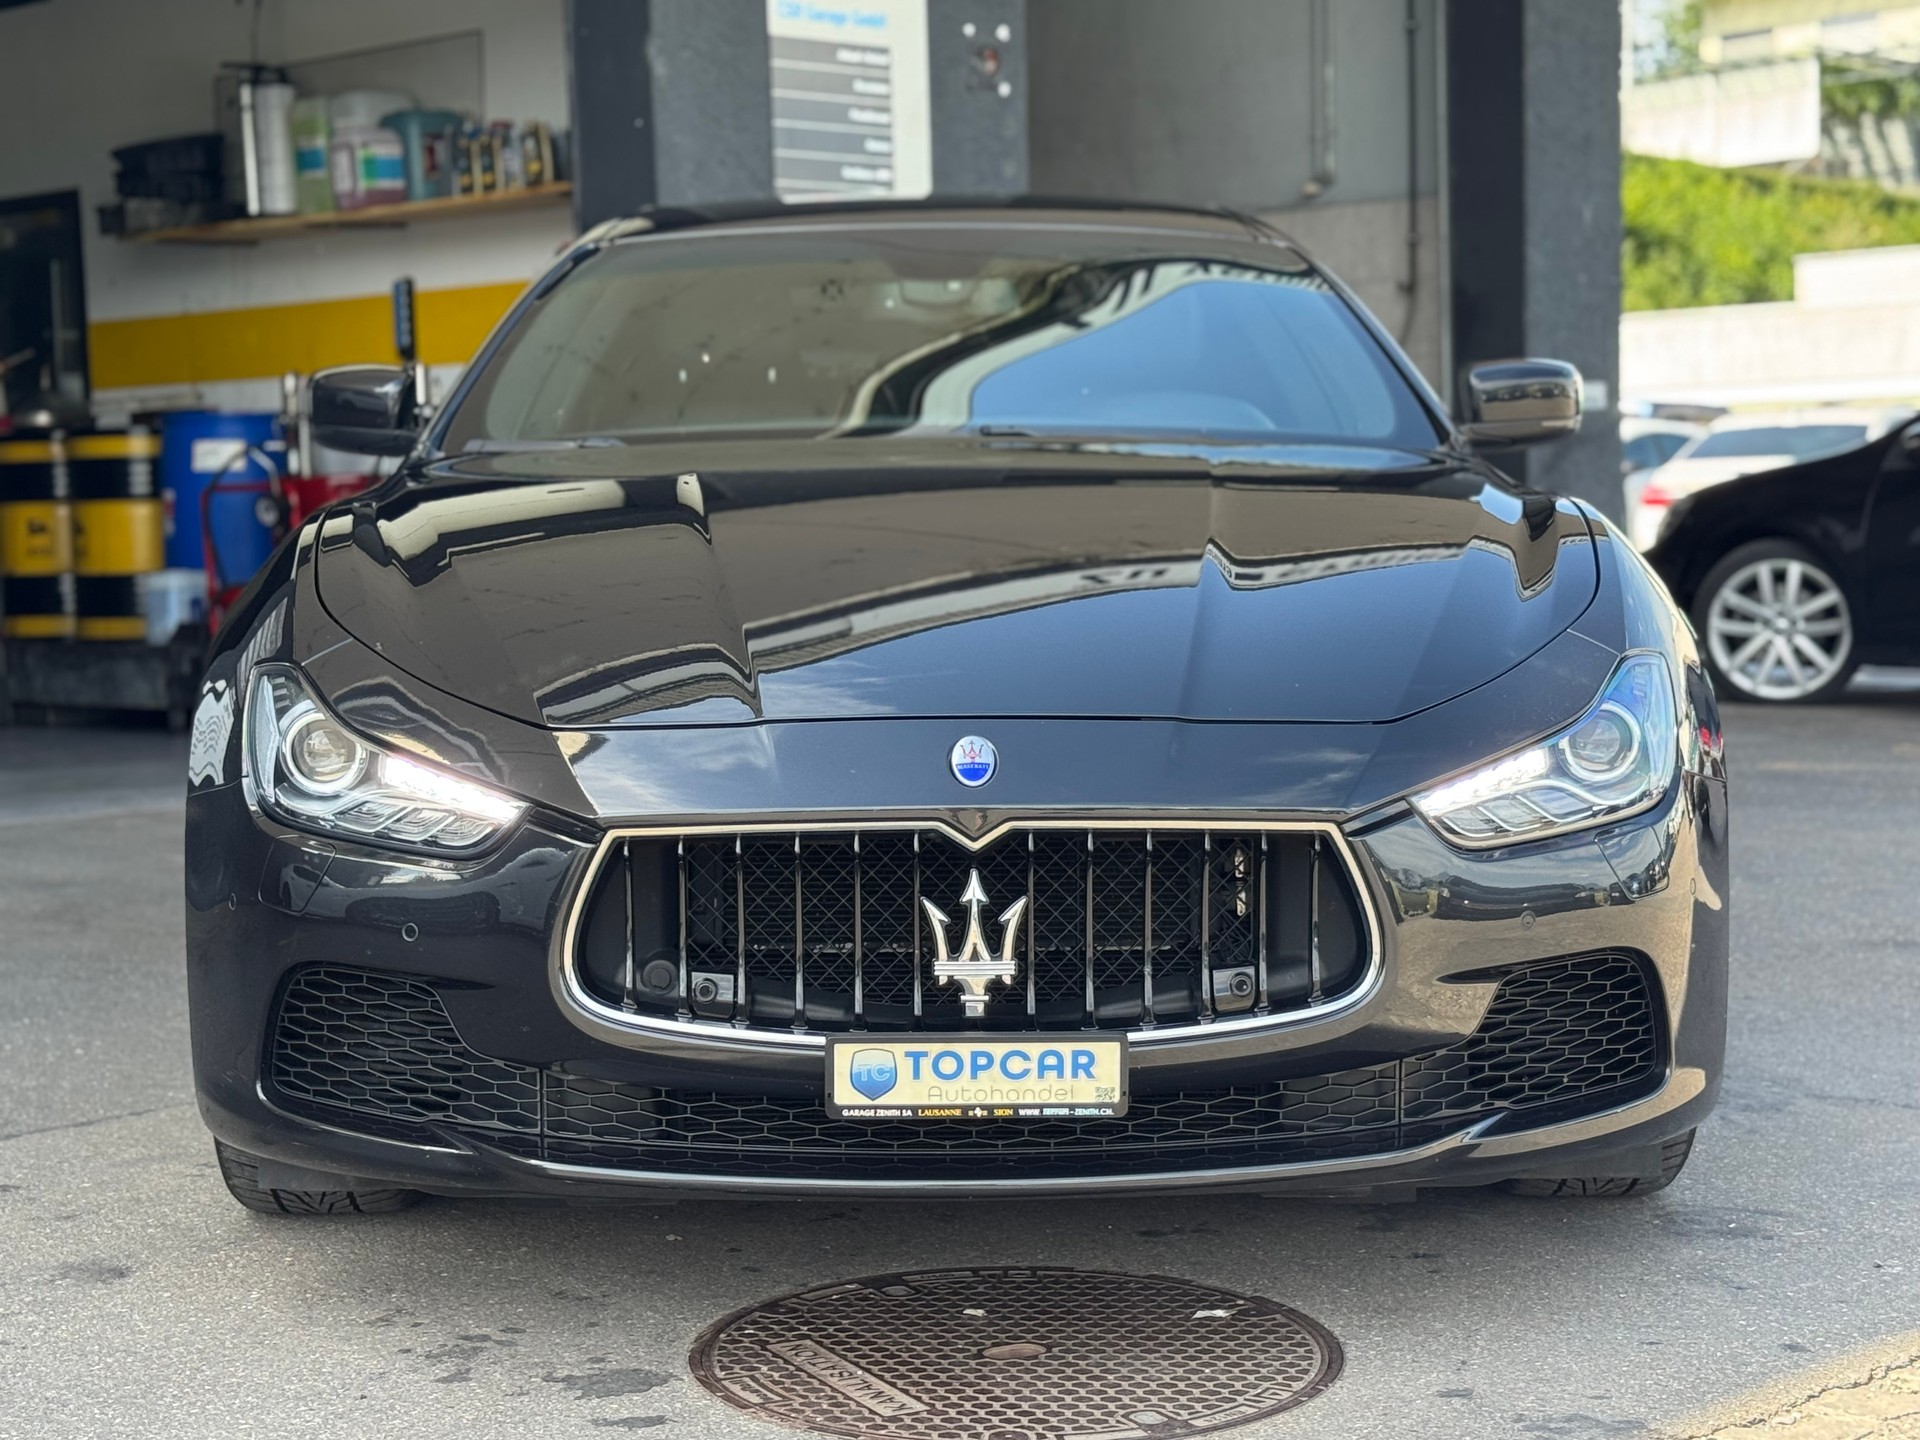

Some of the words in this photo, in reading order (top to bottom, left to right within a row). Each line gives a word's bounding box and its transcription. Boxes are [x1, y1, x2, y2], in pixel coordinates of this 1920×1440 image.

[857, 1063, 891, 1082] TC
[904, 1049, 1097, 1081] TOPCAR
[928, 1084, 1074, 1102] Autohandel
[842, 1108, 875, 1117] GARAGE
[902, 1108, 913, 1117] SA
[917, 1108, 963, 1117] LAUSANNE
[993, 1108, 1014, 1117] SION
[781, 1343, 914, 1413] KANALISATION
